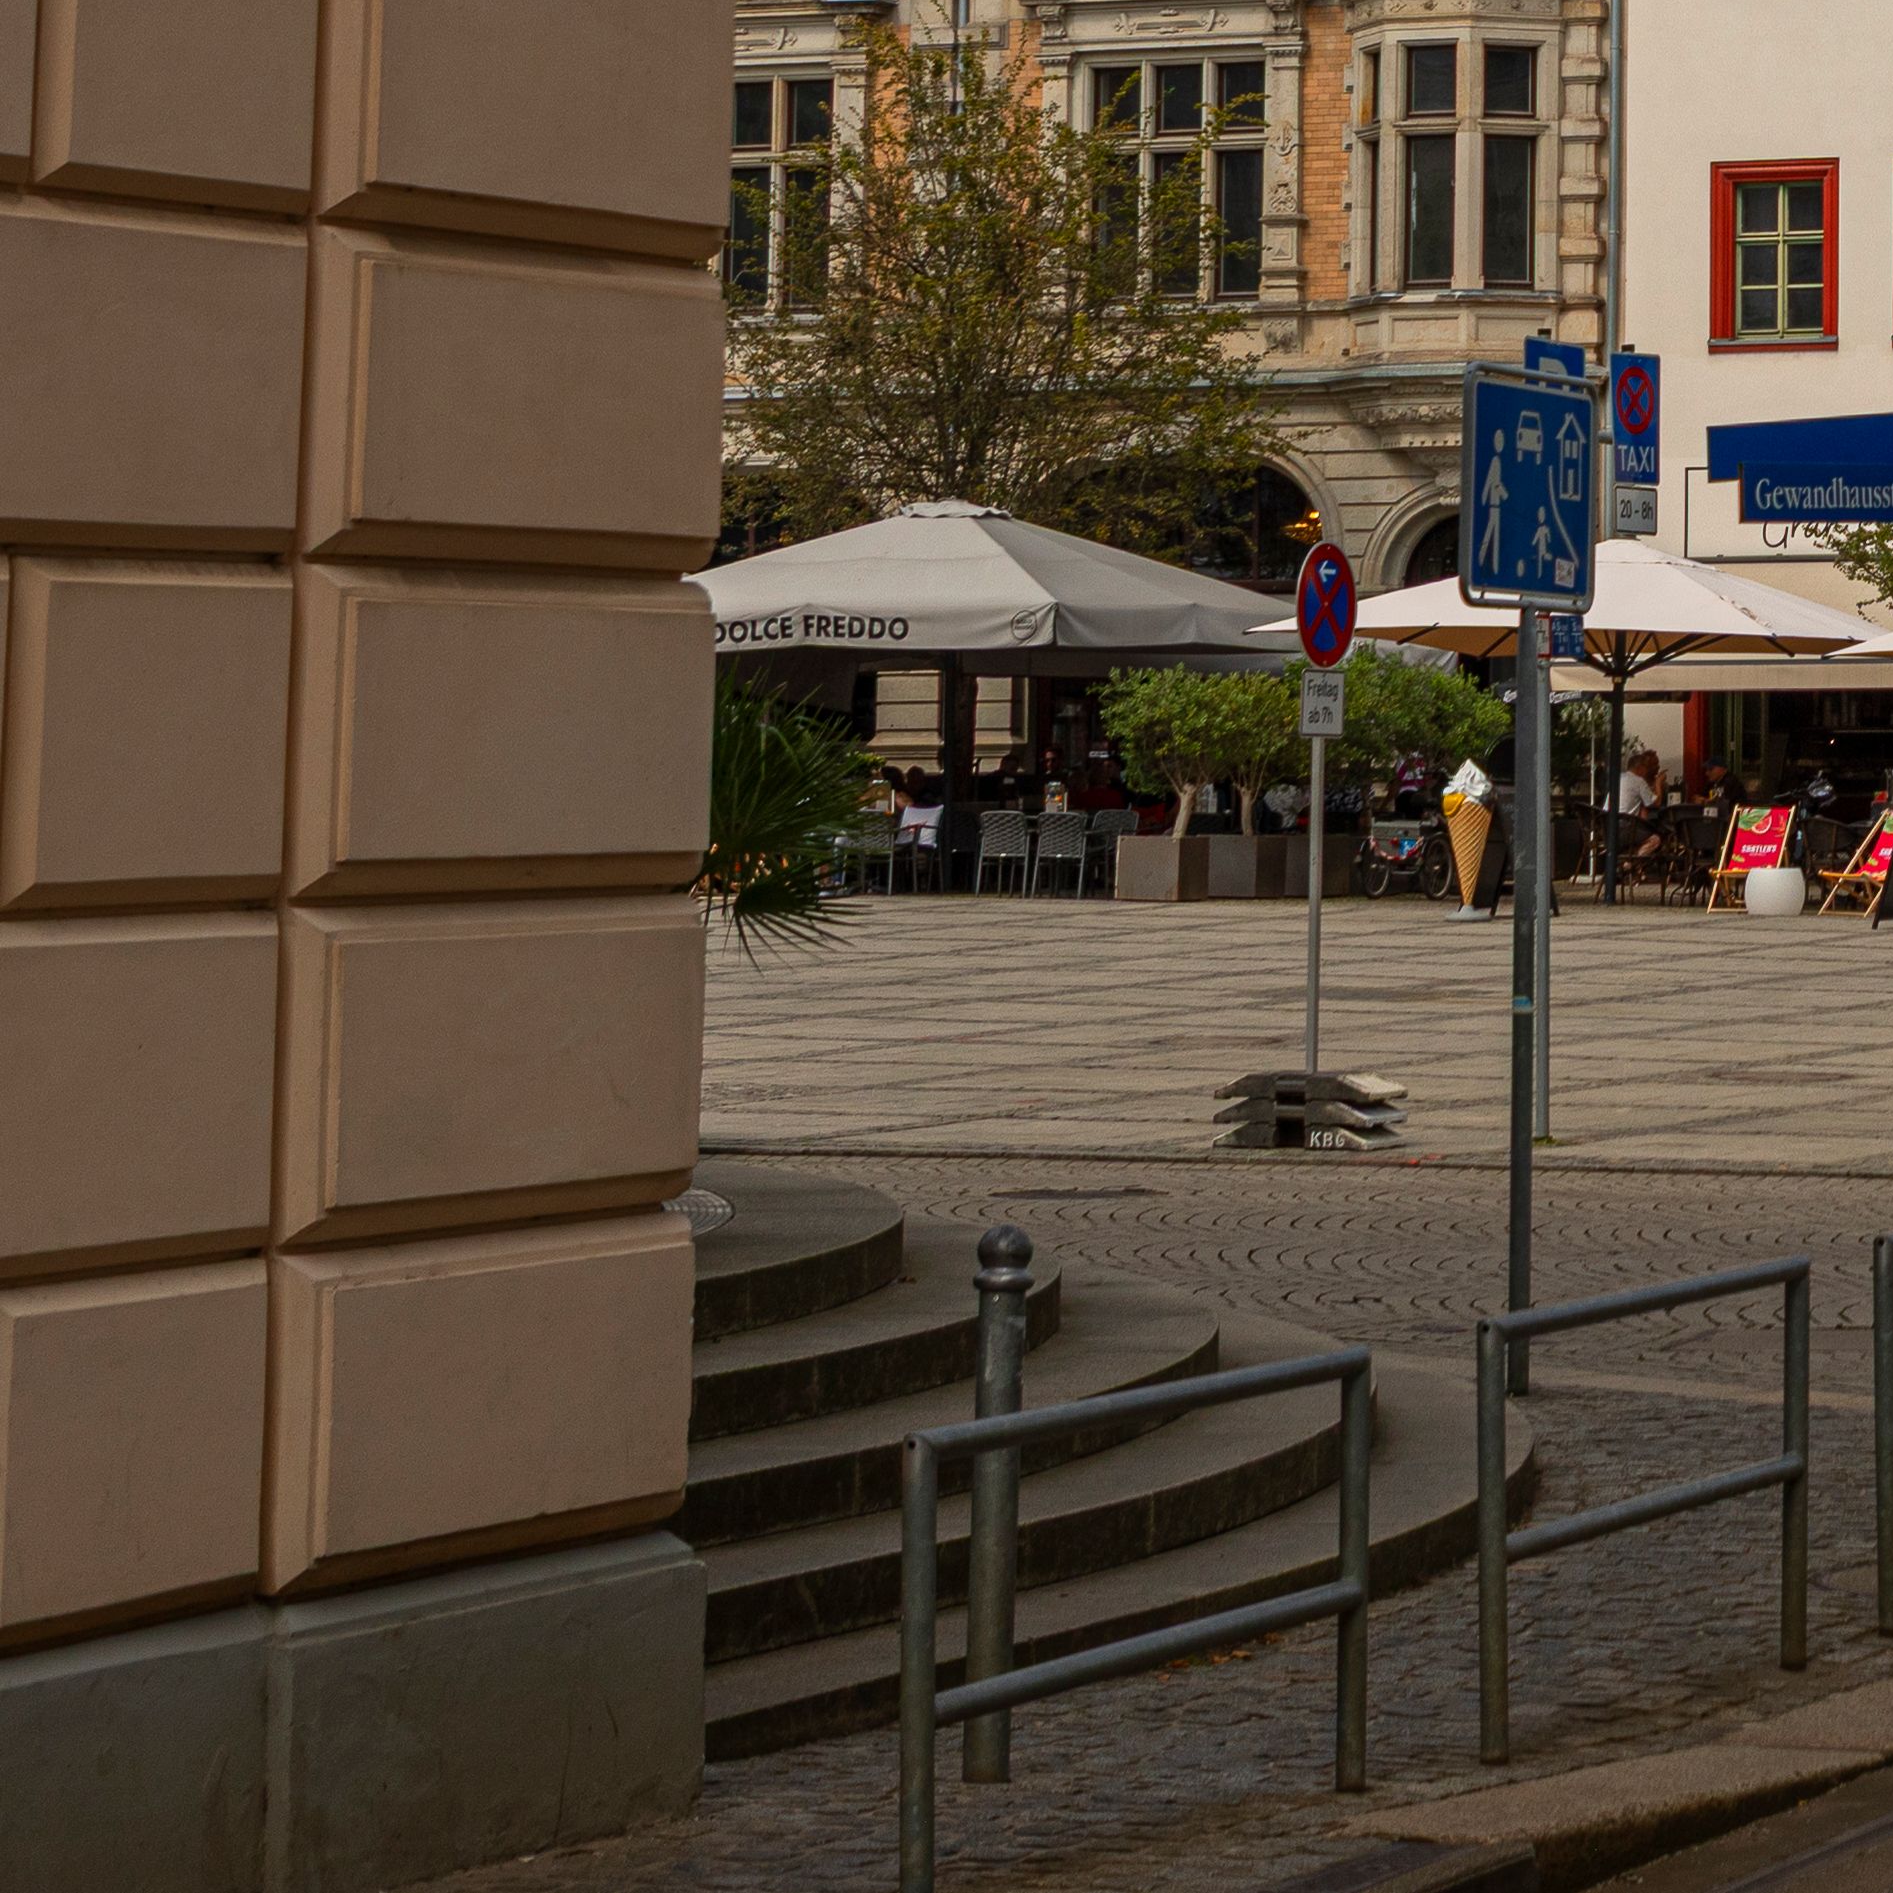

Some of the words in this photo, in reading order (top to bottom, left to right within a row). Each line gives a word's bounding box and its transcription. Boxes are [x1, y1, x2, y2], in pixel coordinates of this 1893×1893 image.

[1617, 444, 1656, 473] TAXI
[1620, 499, 1632, 519] 20
[715, 616, 793, 644] DOLCE
[802, 613, 909, 641] FREDDO
[1306, 678, 1340, 702] Freitag
